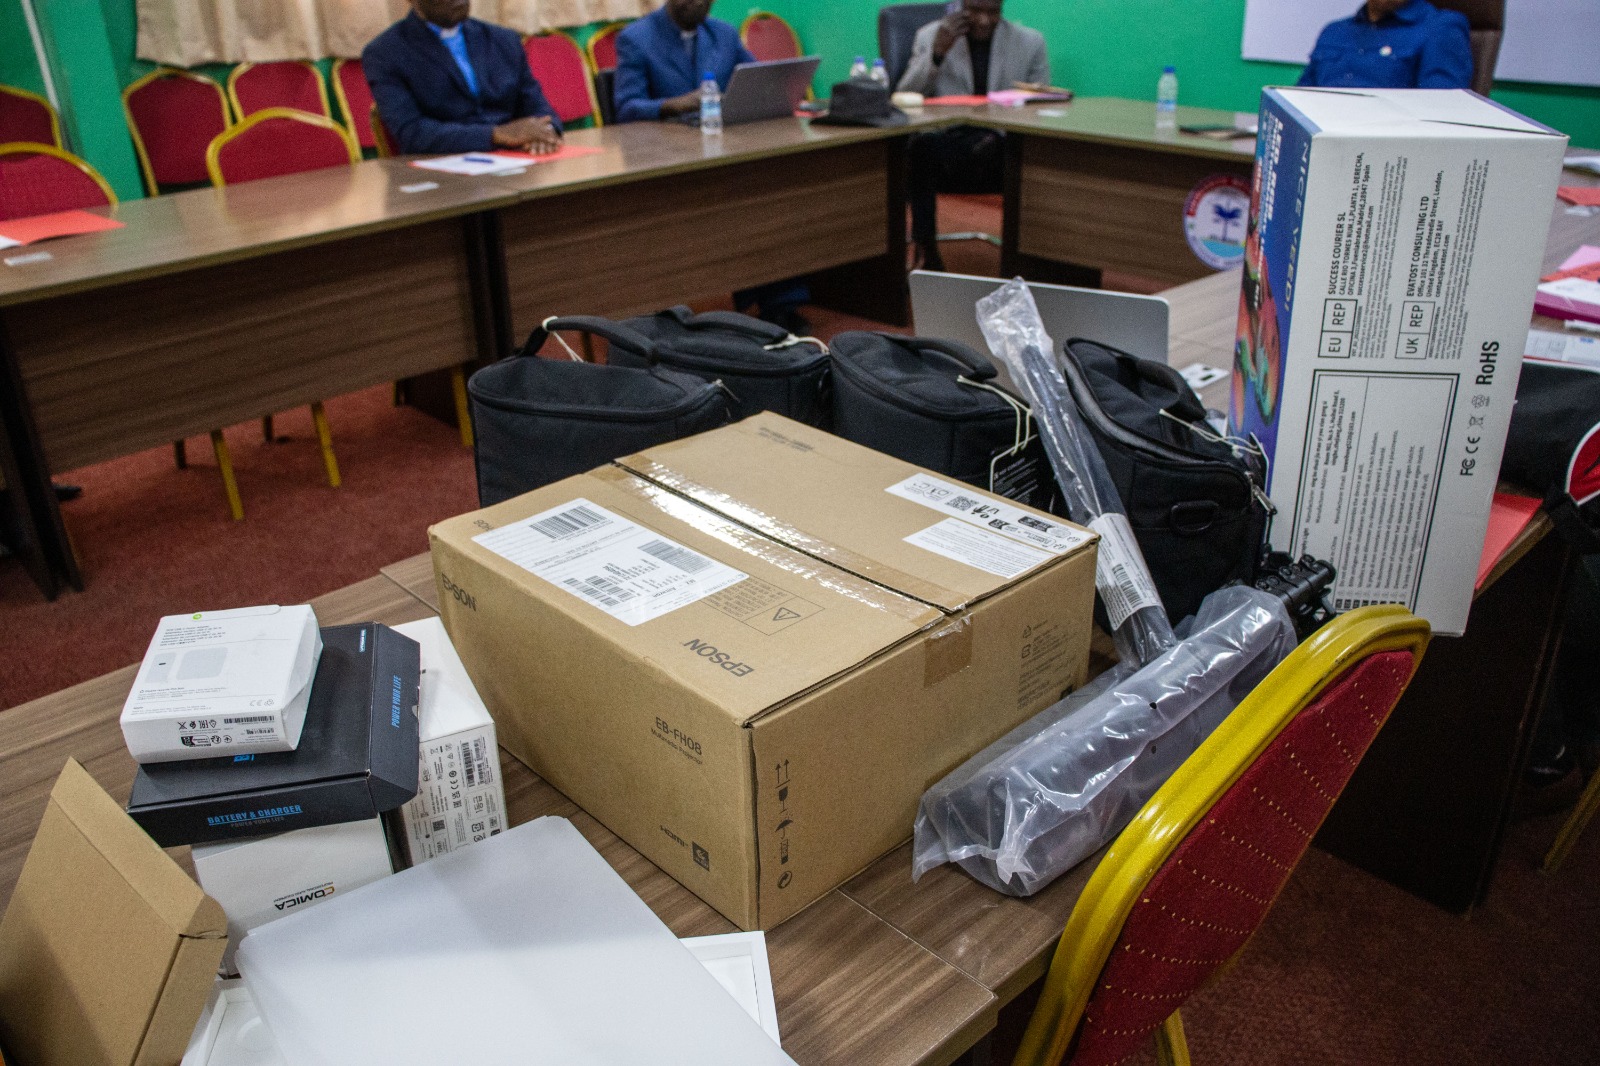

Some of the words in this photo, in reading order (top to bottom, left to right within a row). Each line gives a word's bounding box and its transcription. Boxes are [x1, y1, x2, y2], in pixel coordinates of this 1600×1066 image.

[1353, 152, 1363, 183] DERECHA,
[1419, 196, 1429, 210] LTD
[1422, 218, 1435, 258] Threadneedle
[1432, 170, 1443, 195] London,
[1336, 212, 1346, 221] SL
[1332, 223, 1344, 258] COURIER
[1346, 271, 1356, 295] OFICINA
[1362, 164, 1371, 182] Spain
[1411, 212, 1427, 261] CONSULTING
[1342, 239, 1352, 263] TORMES
[1327, 260, 1339, 294] SUCCESS
[1340, 265, 1348, 275] RIO
[1406, 263, 1419, 296] EVATOST
[1338, 277, 1347, 294] CALLE
[1425, 278, 1434, 296] United
[1331, 302, 1346, 325] REP
[1409, 304, 1424, 327] REP
[1328, 337, 1341, 352] EU
[1405, 338, 1419, 353] UK
[1475, 340, 1500, 385] RoHS
[441, 573, 476, 612] EPSON
[686, 638, 754, 678] EPSON
[393, 674, 402, 690] LIFE
[392, 688, 400, 706] YOUR
[392, 704, 400, 728] POWER
[207, 812, 247, 825] BATTERY
[249, 811, 257, 819] &
[258, 804, 302, 817] CHARGER
[275, 886, 335, 910] COMICA
